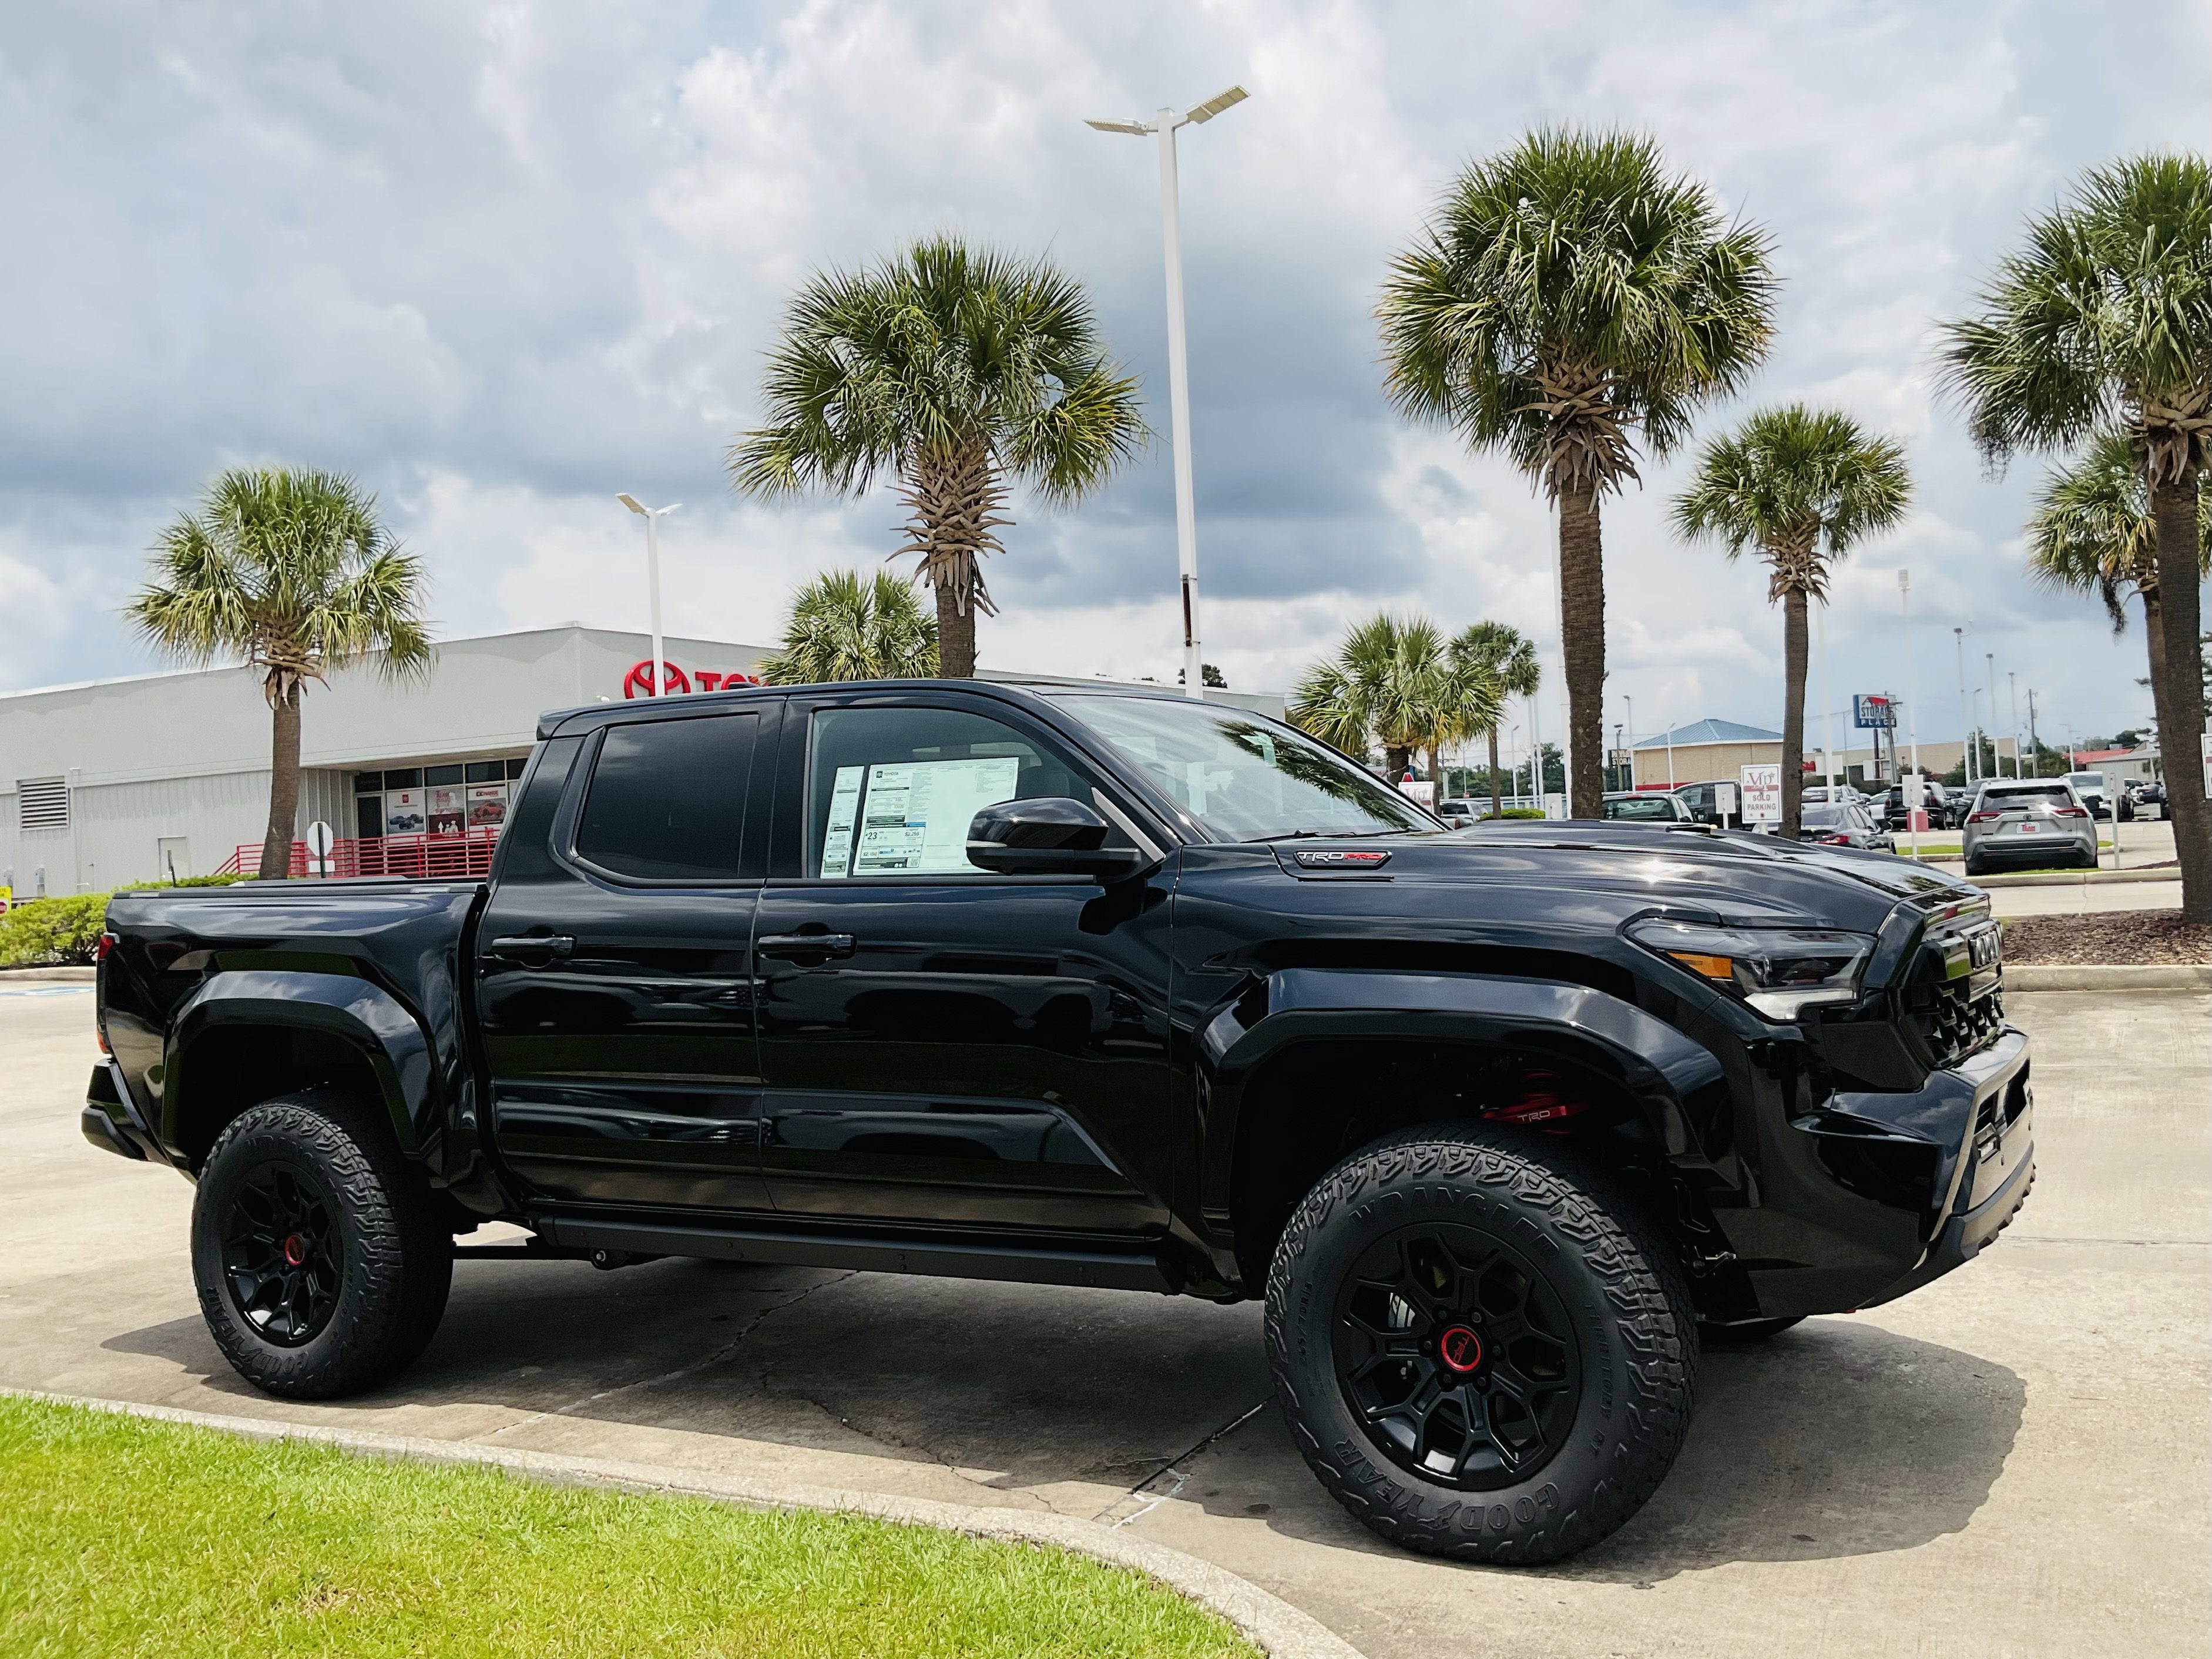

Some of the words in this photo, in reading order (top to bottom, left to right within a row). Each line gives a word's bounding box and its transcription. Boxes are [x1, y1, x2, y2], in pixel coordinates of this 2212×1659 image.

[867, 832, 878, 840] 23
[1297, 852, 1345, 862] TRD
[1517, 1110, 1550, 1122] TRD
[1348, 1187, 1560, 1262] WRANGLER
[1334, 1438, 1560, 1531] GOODYEAR
